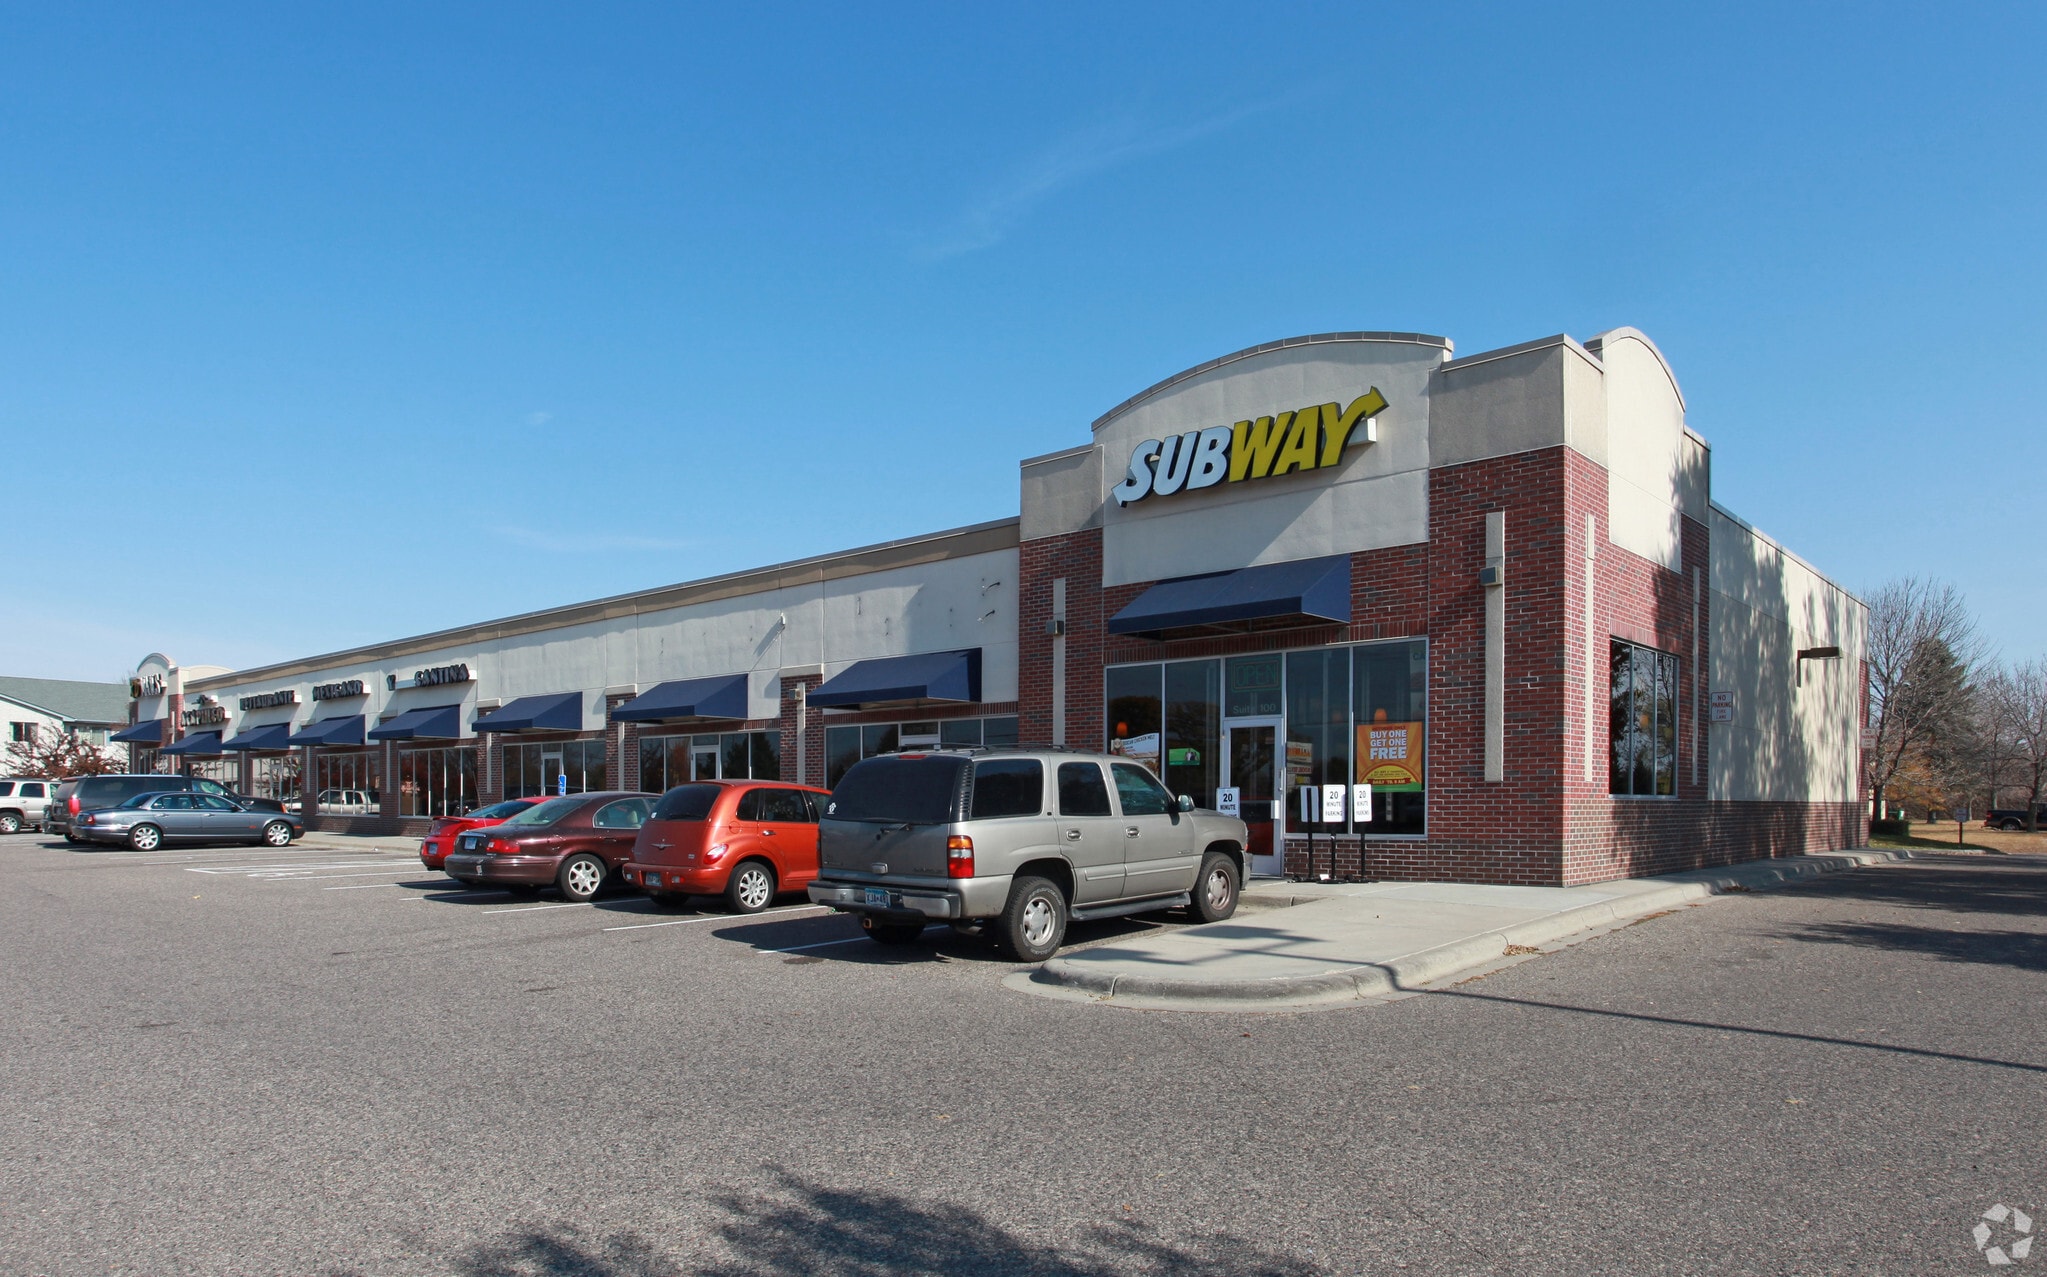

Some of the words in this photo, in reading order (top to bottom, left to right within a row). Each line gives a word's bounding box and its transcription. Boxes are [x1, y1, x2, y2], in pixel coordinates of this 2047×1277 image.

[1111, 386, 1388, 506] SUBWAY
[312, 680, 364, 702] MEXICANO
[386, 674, 396, 691] Y
[414, 663, 469, 687] CANTINA
[1260, 703, 1277, 713] 100
[1370, 730, 1387, 739] BUY
[1389, 729, 1407, 738] ONE
[1370, 739, 1387, 747] GET
[1389, 738, 1407, 746] ONE
[1370, 747, 1407, 760] FREE
[1223, 793, 1233, 802] 20
[1329, 791, 1339, 799] 20
[1359, 790, 1367, 798] 20
